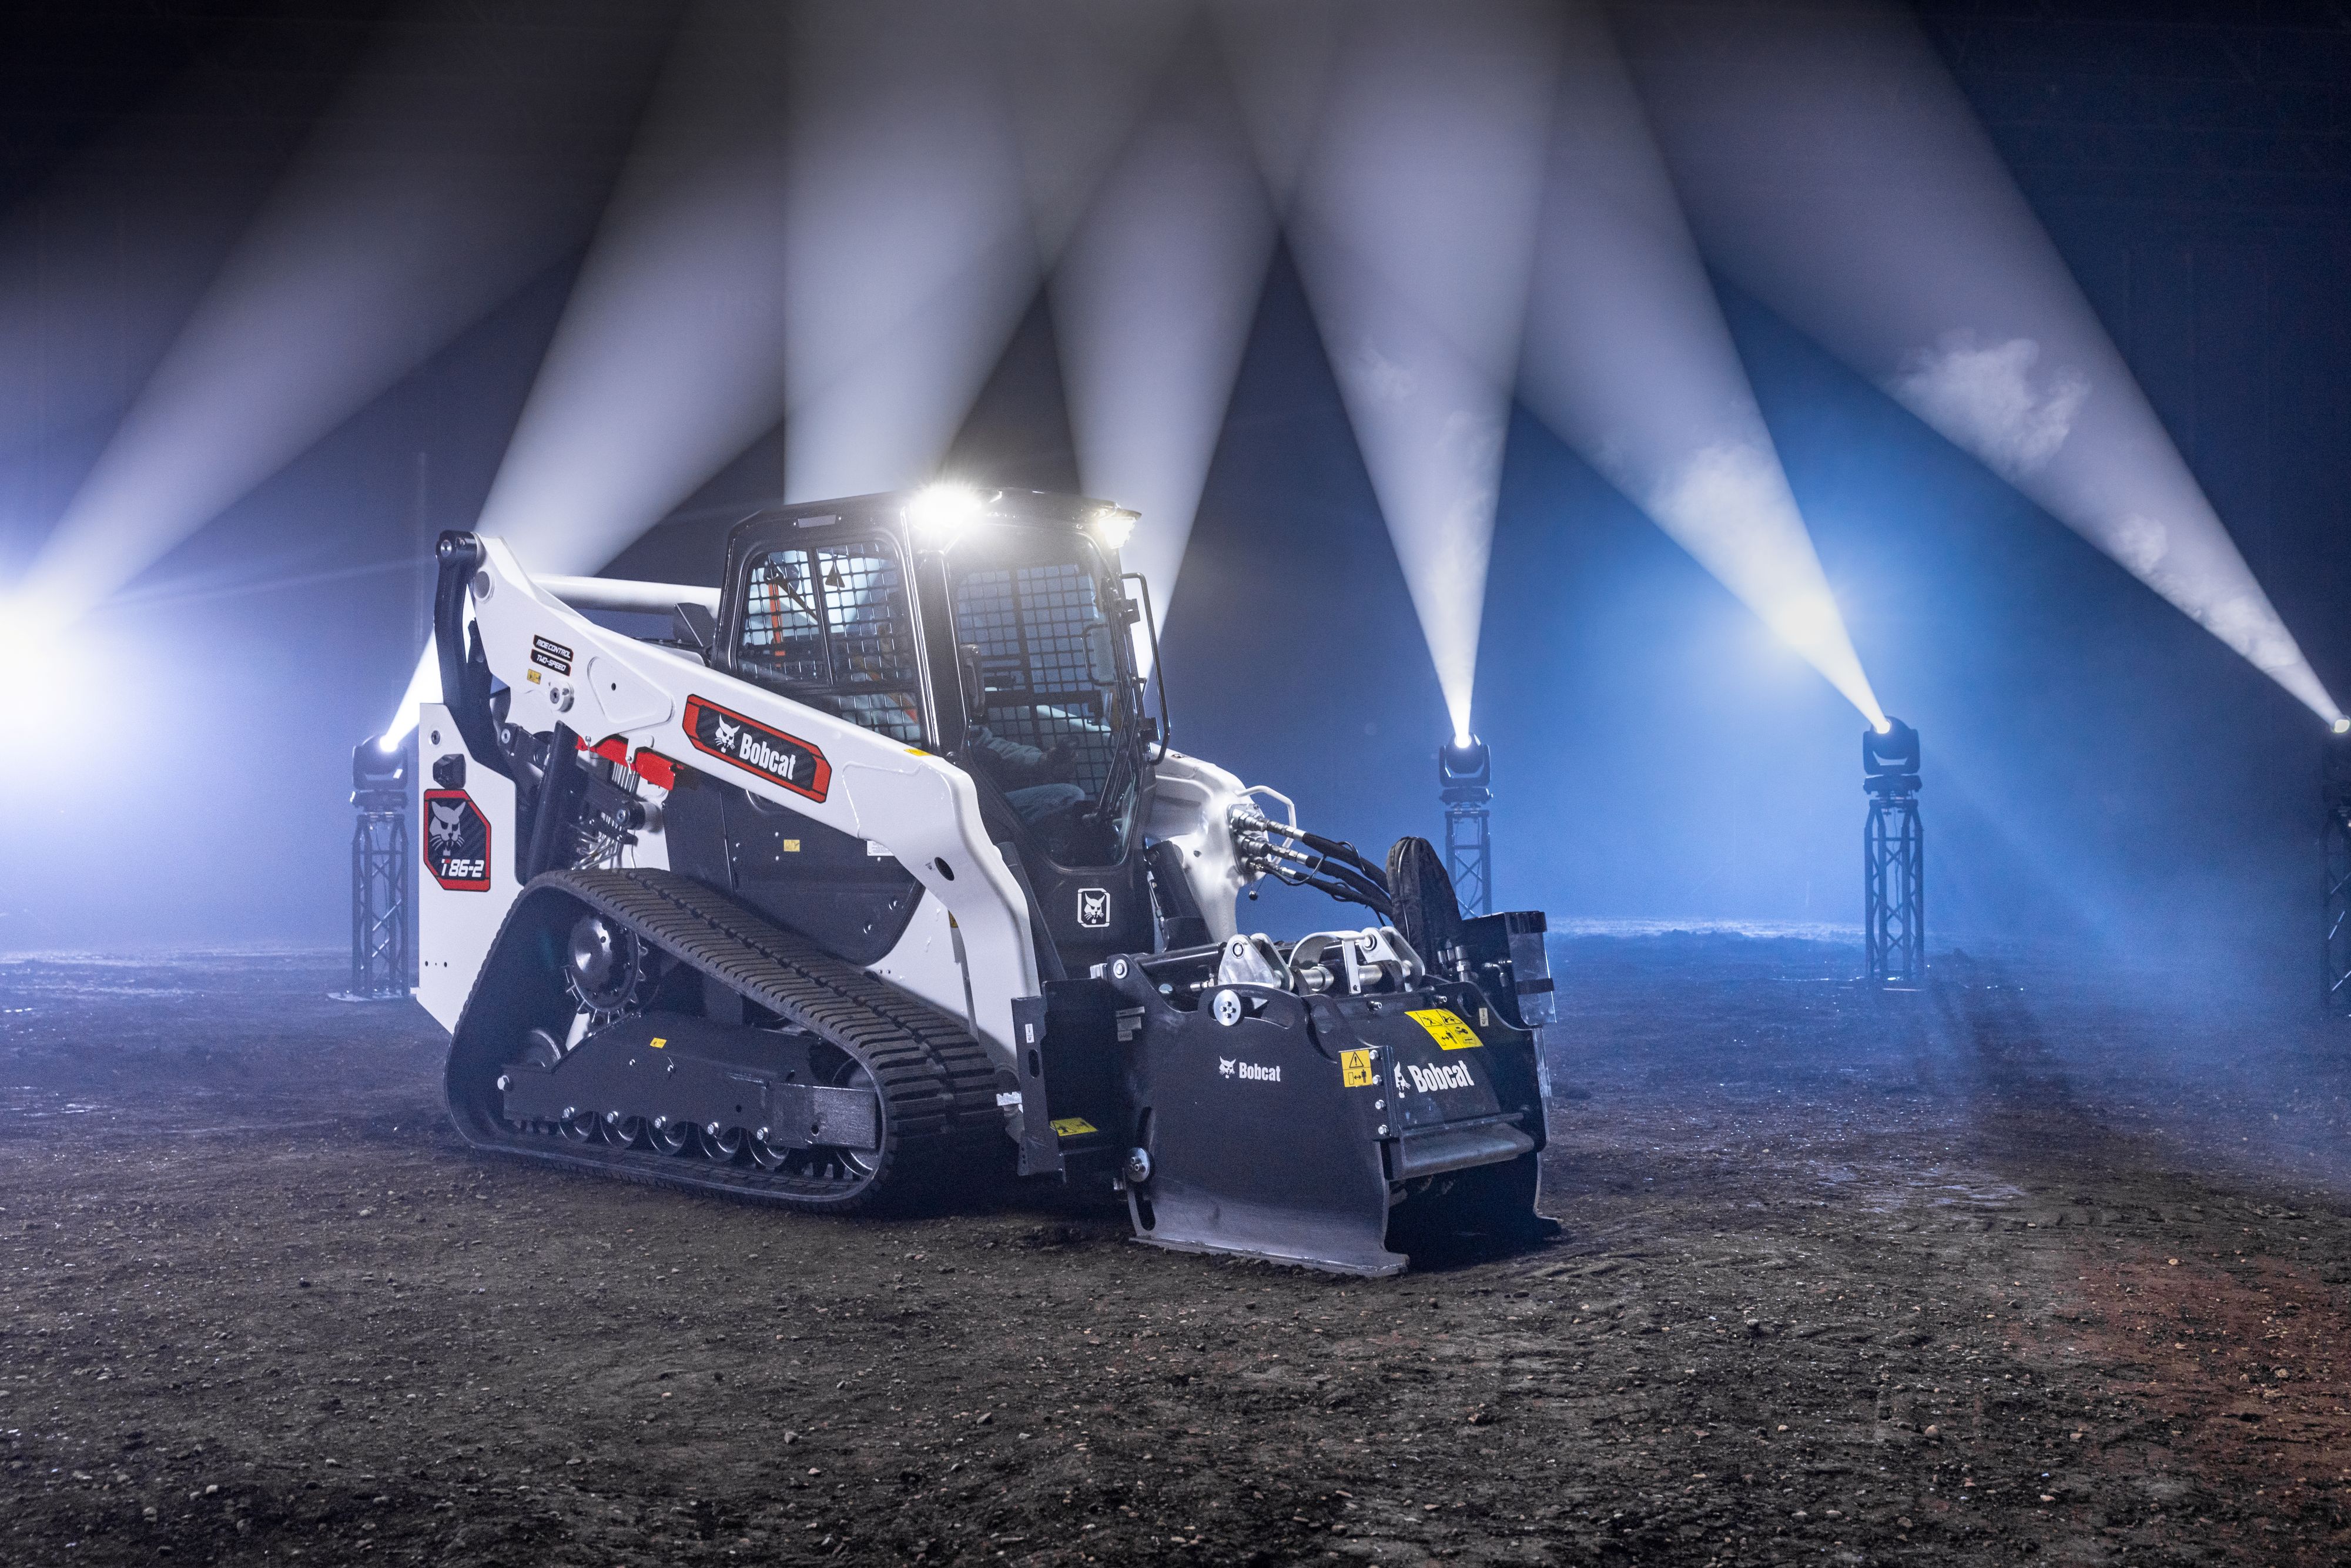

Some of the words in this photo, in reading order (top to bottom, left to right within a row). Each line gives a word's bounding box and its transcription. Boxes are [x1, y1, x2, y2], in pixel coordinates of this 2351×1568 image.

[536, 639, 549, 649] RIDE
[547, 644, 571, 658] CONTROL
[537, 654, 566, 671] TWO-SPEED
[739, 732, 796, 780] Bobcat
[441, 859, 485, 877] T86-2
[1239, 1062, 1281, 1081] Bobcat
[1407, 1060, 1475, 1093] Bobcat
